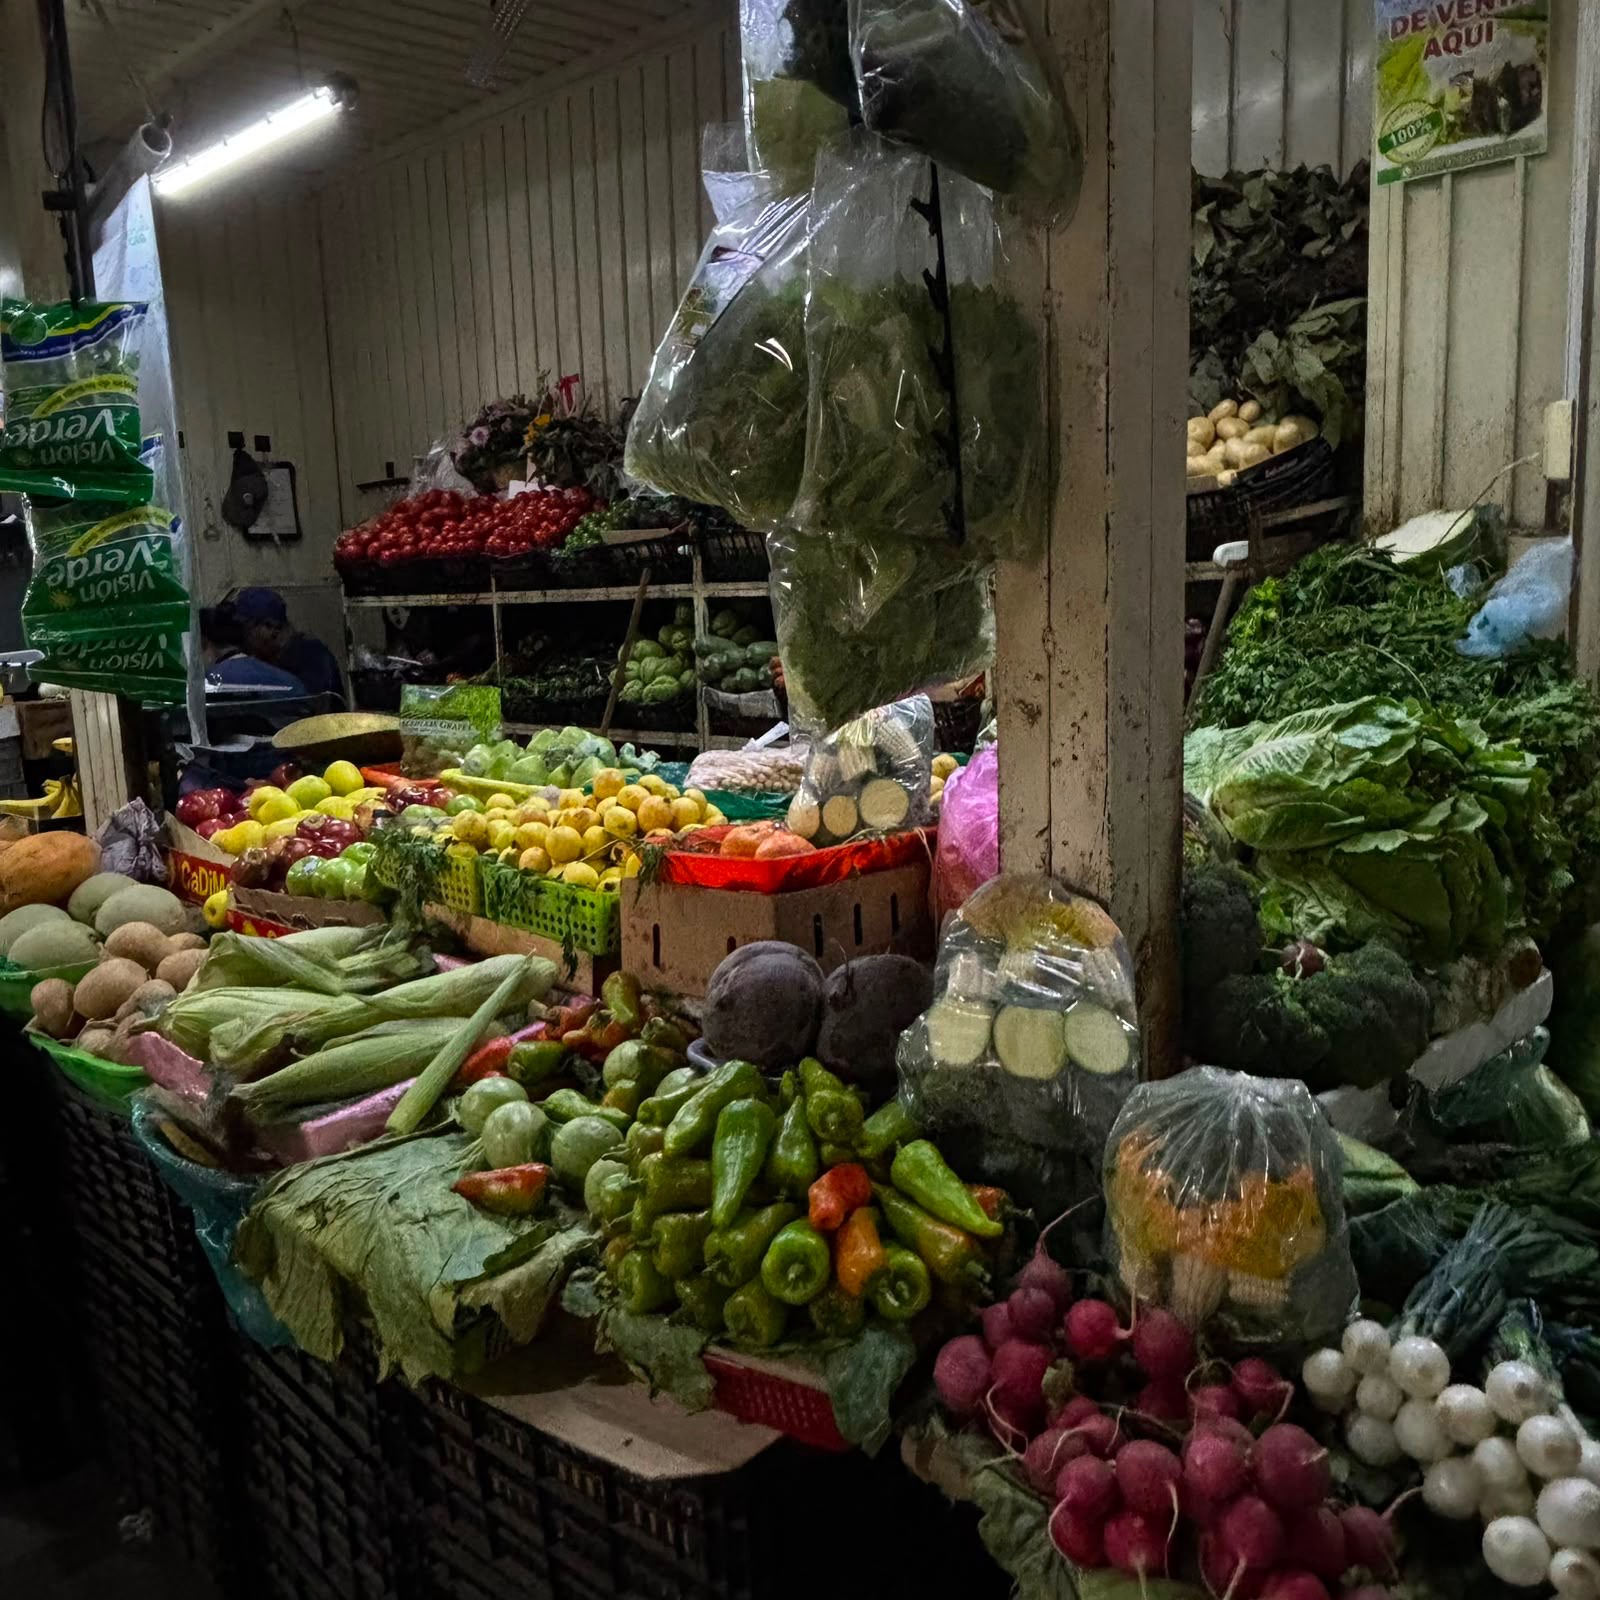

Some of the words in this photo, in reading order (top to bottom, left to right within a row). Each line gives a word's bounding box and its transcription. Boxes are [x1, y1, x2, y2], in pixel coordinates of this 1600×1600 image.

[1390, 10, 1427, 40] DE
[1436, 0, 1519, 24] VEN
[1424, 20, 1493, 60] AQUI
[1389, 118, 1433, 147] 100%
[7, 408, 116, 448] Verde
[45, 540, 153, 588] Verde
